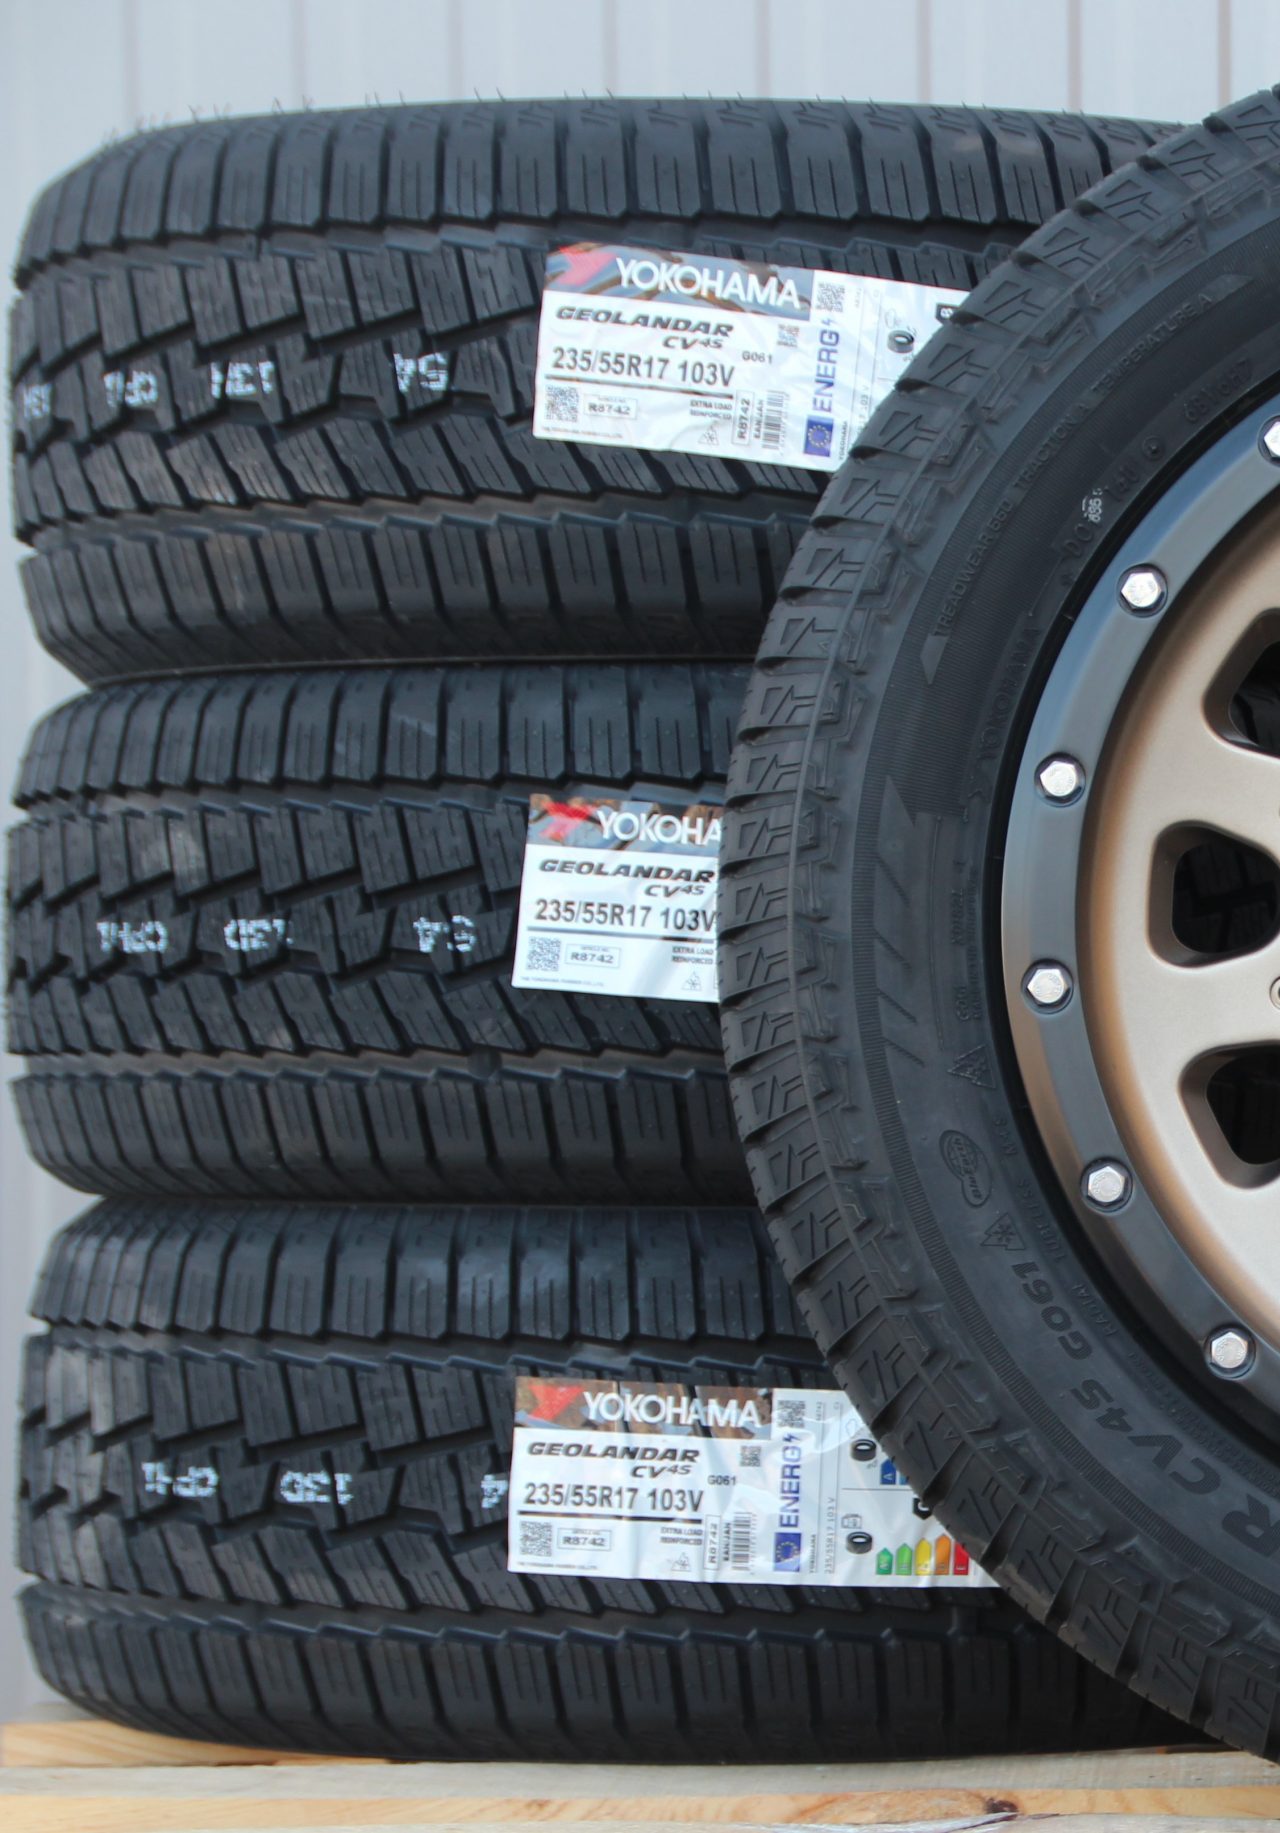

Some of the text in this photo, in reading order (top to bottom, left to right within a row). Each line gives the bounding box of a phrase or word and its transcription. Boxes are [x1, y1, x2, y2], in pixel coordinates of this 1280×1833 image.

[615, 257, 801, 309] YOKOHAMA
[556, 306, 734, 337] GEOLANDAR
[553, 346, 736, 387] 235/55R17 103V
[741, 350, 774, 364] G061
[813, 328, 840, 412] ENERG
[588, 402, 631, 415] R8742
[738, 398, 750, 439] R8742
[931, 531, 995, 638] TREADWEAR
[1010, 413, 1078, 493] TRACTION
[1089, 303, 1198, 398] TEMPERATURE
[1192, 289, 1214, 310] A
[597, 810, 721, 846] YOKOHA
[538, 859, 715, 883] GEOLANDAR
[644, 884, 705, 898] CV4S
[535, 897, 717, 932] 235/55R17 103V
[570, 951, 614, 964] R8742
[1011, 1256, 1094, 1364] G061
[583, 1391, 762, 1428] YOKOHAMA
[528, 1441, 700, 1463] GEOLANDAR
[1072, 1365, 1222, 1509] CV4S
[631, 1465, 692, 1478] CV4S
[708, 1475, 737, 1486] G061
[780, 1445, 801, 1528] ENERG
[523, 1482, 639, 1509] 235/55R17
[646, 1488, 704, 1512] 103V
[562, 1536, 605, 1546] R8742
